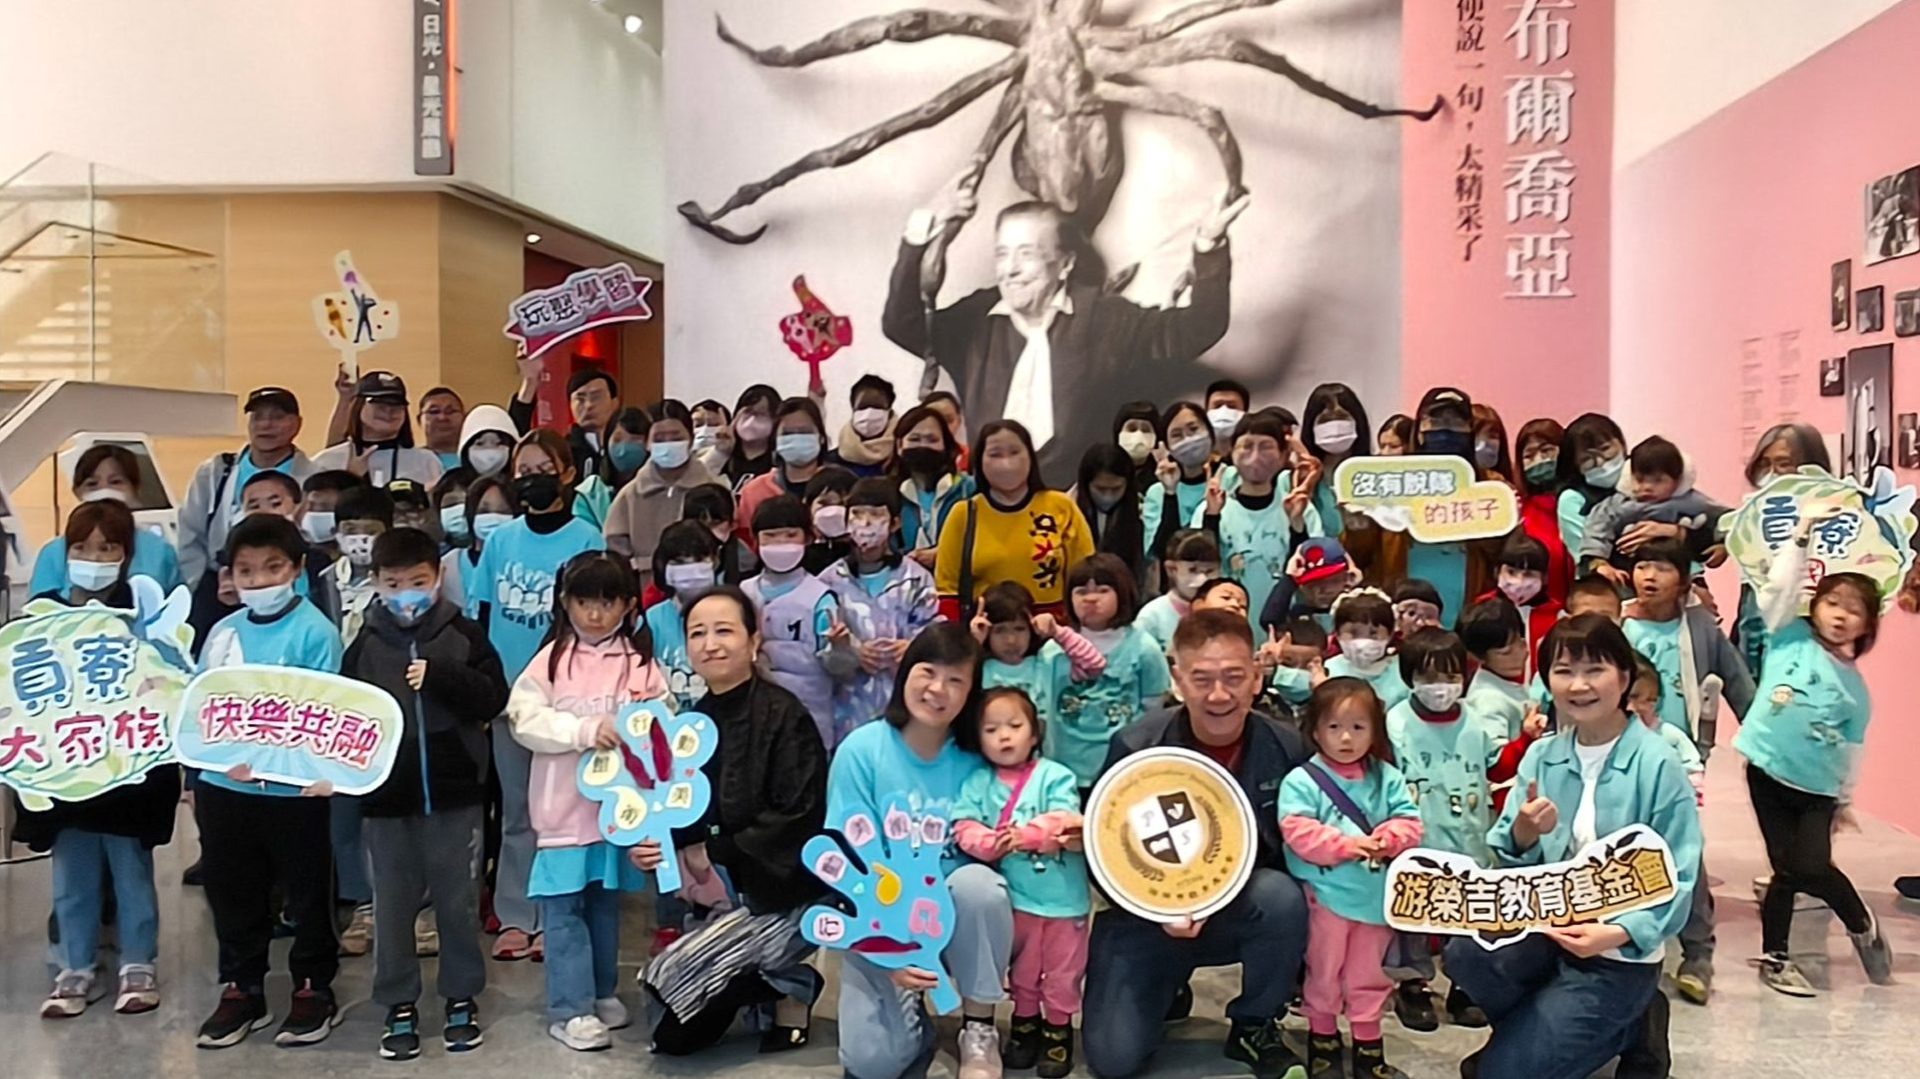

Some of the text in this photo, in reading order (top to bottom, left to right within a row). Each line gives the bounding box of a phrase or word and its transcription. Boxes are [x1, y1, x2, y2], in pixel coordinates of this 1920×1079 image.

[1503, 0, 1577, 298] 布爾喬亞
[1425, 498, 1499, 524] 的孩子
[13, 635, 137, 712] 貢寮
[0, 706, 165, 766] 大家族
[200, 695, 382, 766] 快樂共融
